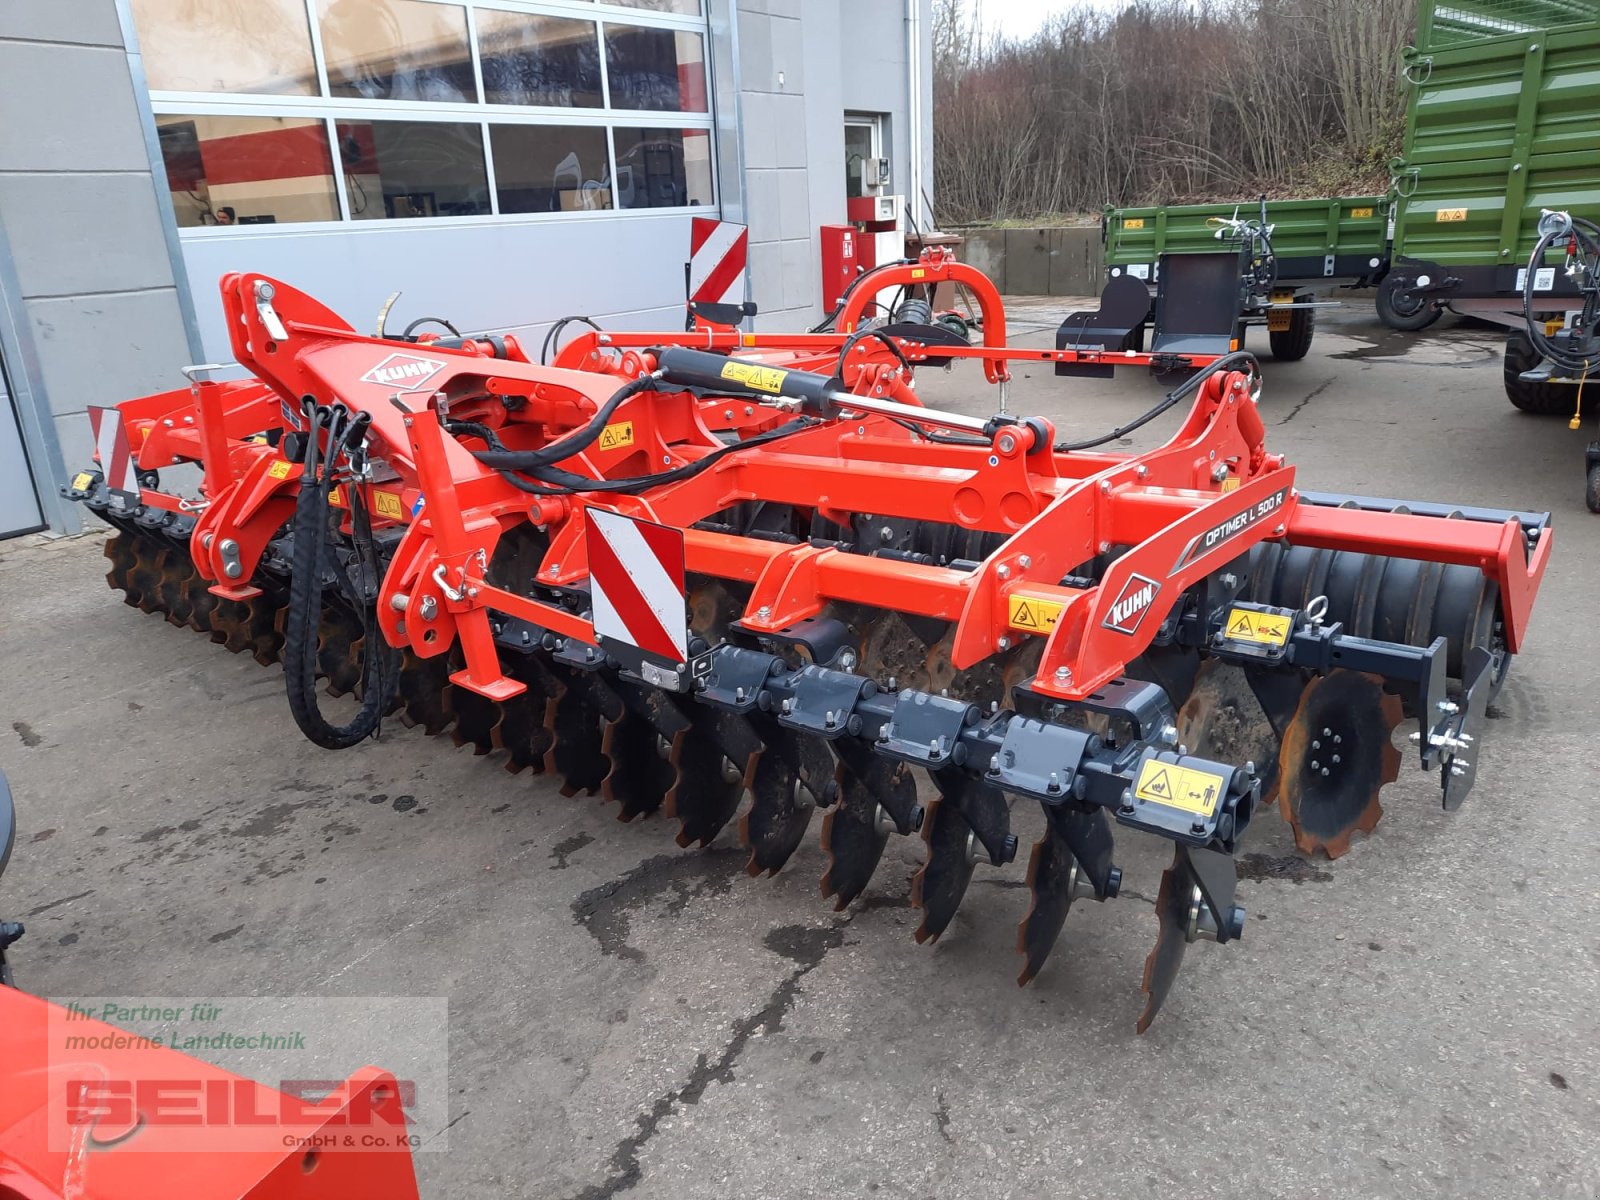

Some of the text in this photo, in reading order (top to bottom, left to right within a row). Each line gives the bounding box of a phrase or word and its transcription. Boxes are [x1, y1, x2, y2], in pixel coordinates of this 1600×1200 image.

[374, 361, 435, 382] KUHN
[1206, 493, 1282, 546] OPTIMER L 500 R
[1112, 584, 1153, 626] KUHN
